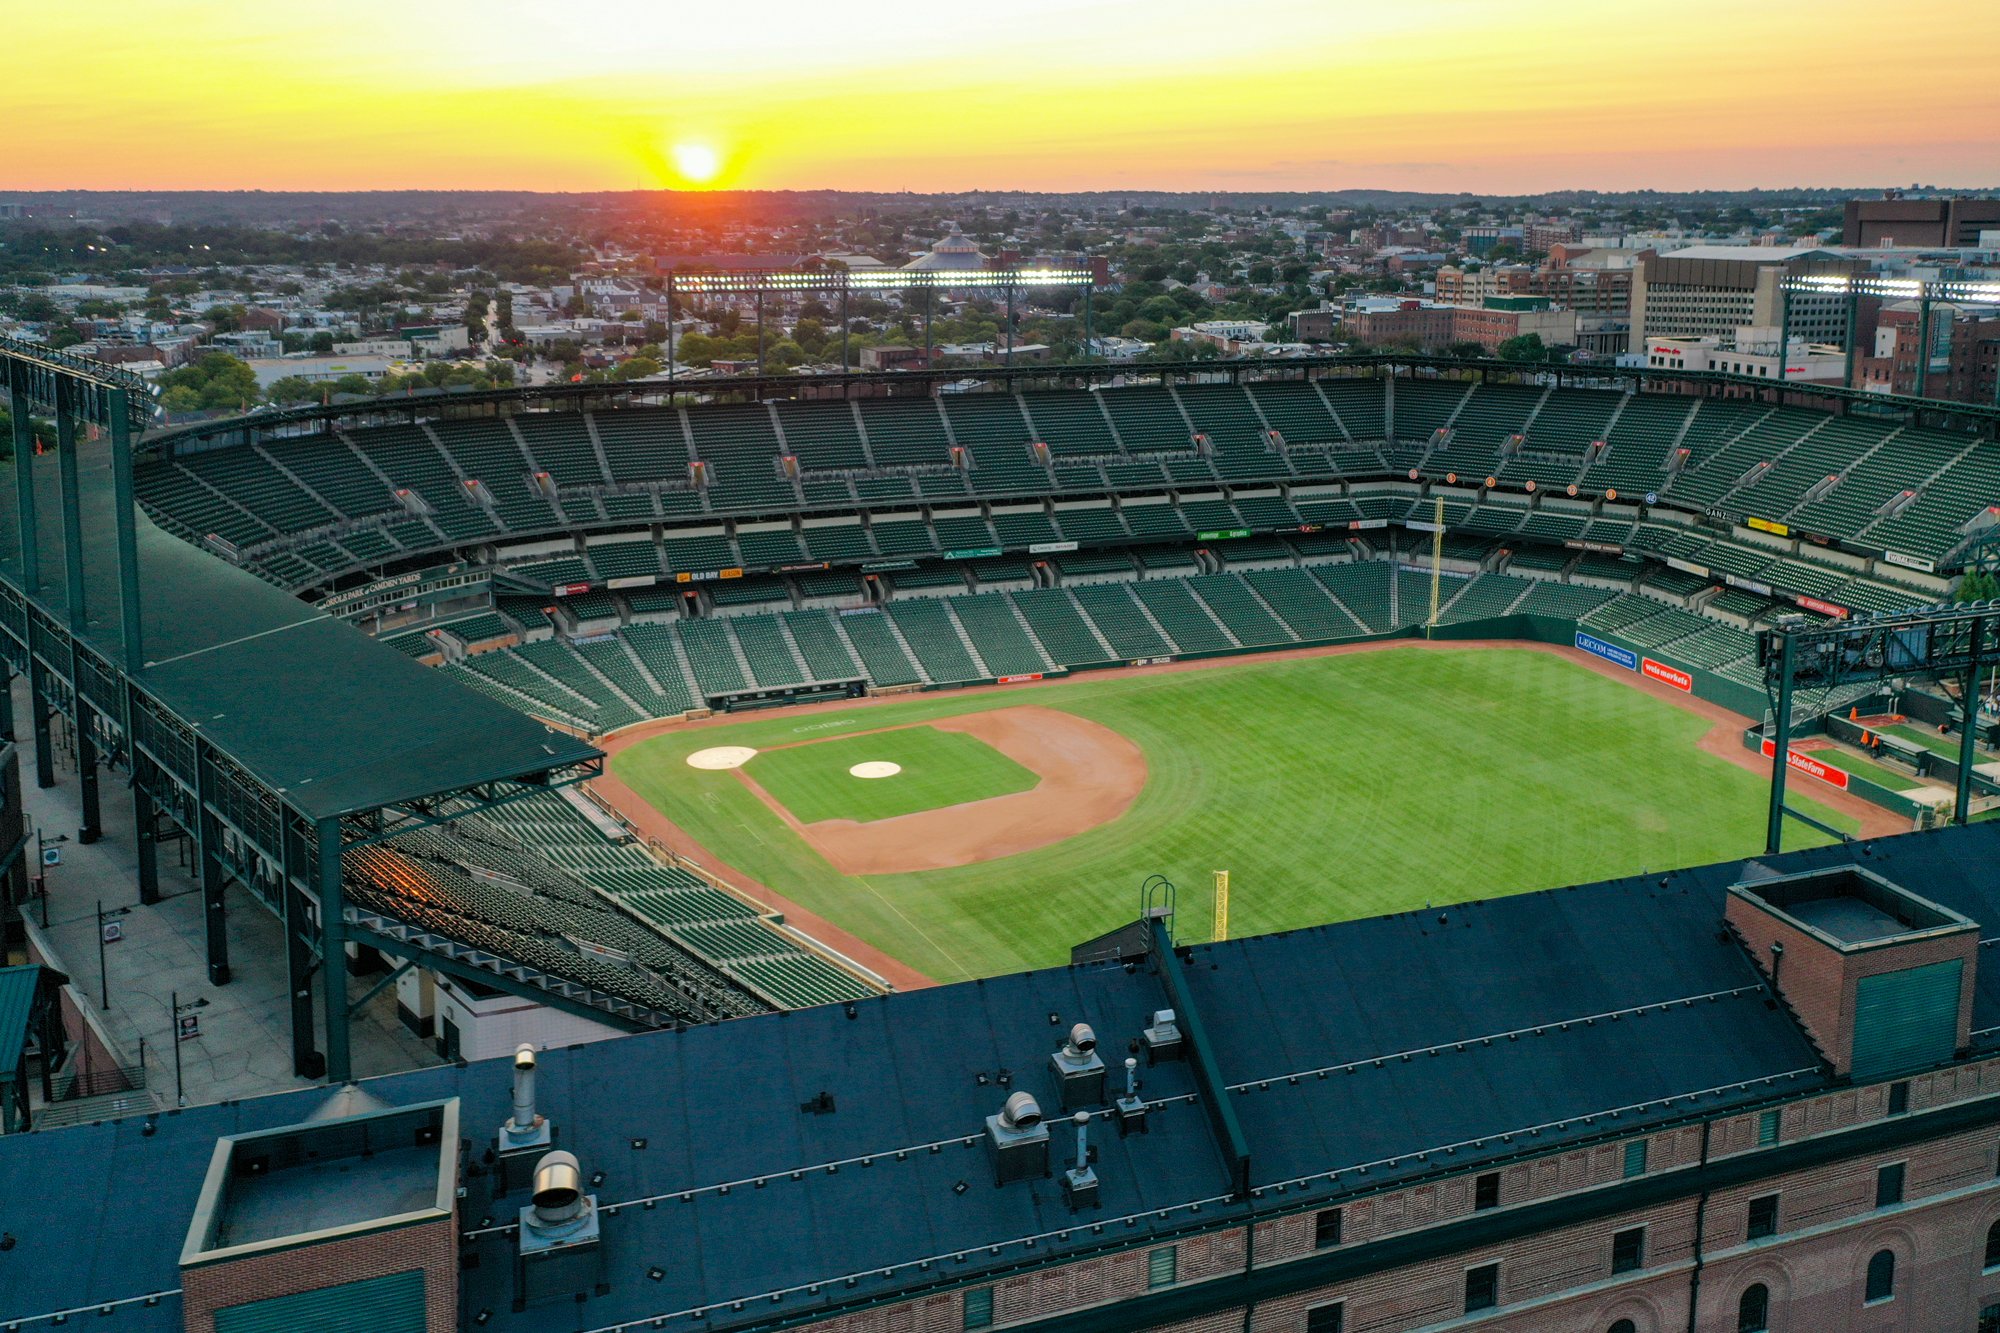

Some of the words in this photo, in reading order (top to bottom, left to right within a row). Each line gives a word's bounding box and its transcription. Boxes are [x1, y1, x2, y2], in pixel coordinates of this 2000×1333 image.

[1705, 508, 1727, 520] GANZ
[691, 572, 705, 581] OLD
[705, 571, 719, 579] BAY
[348, 588, 365, 600] PARK
[369, 578, 398, 592] CAMDEN
[398, 573, 422, 585] YARDS
[1578, 636, 1606, 655] LECOM
[1645, 663, 1660, 675] weis
[1660, 669, 1688, 686] markets
